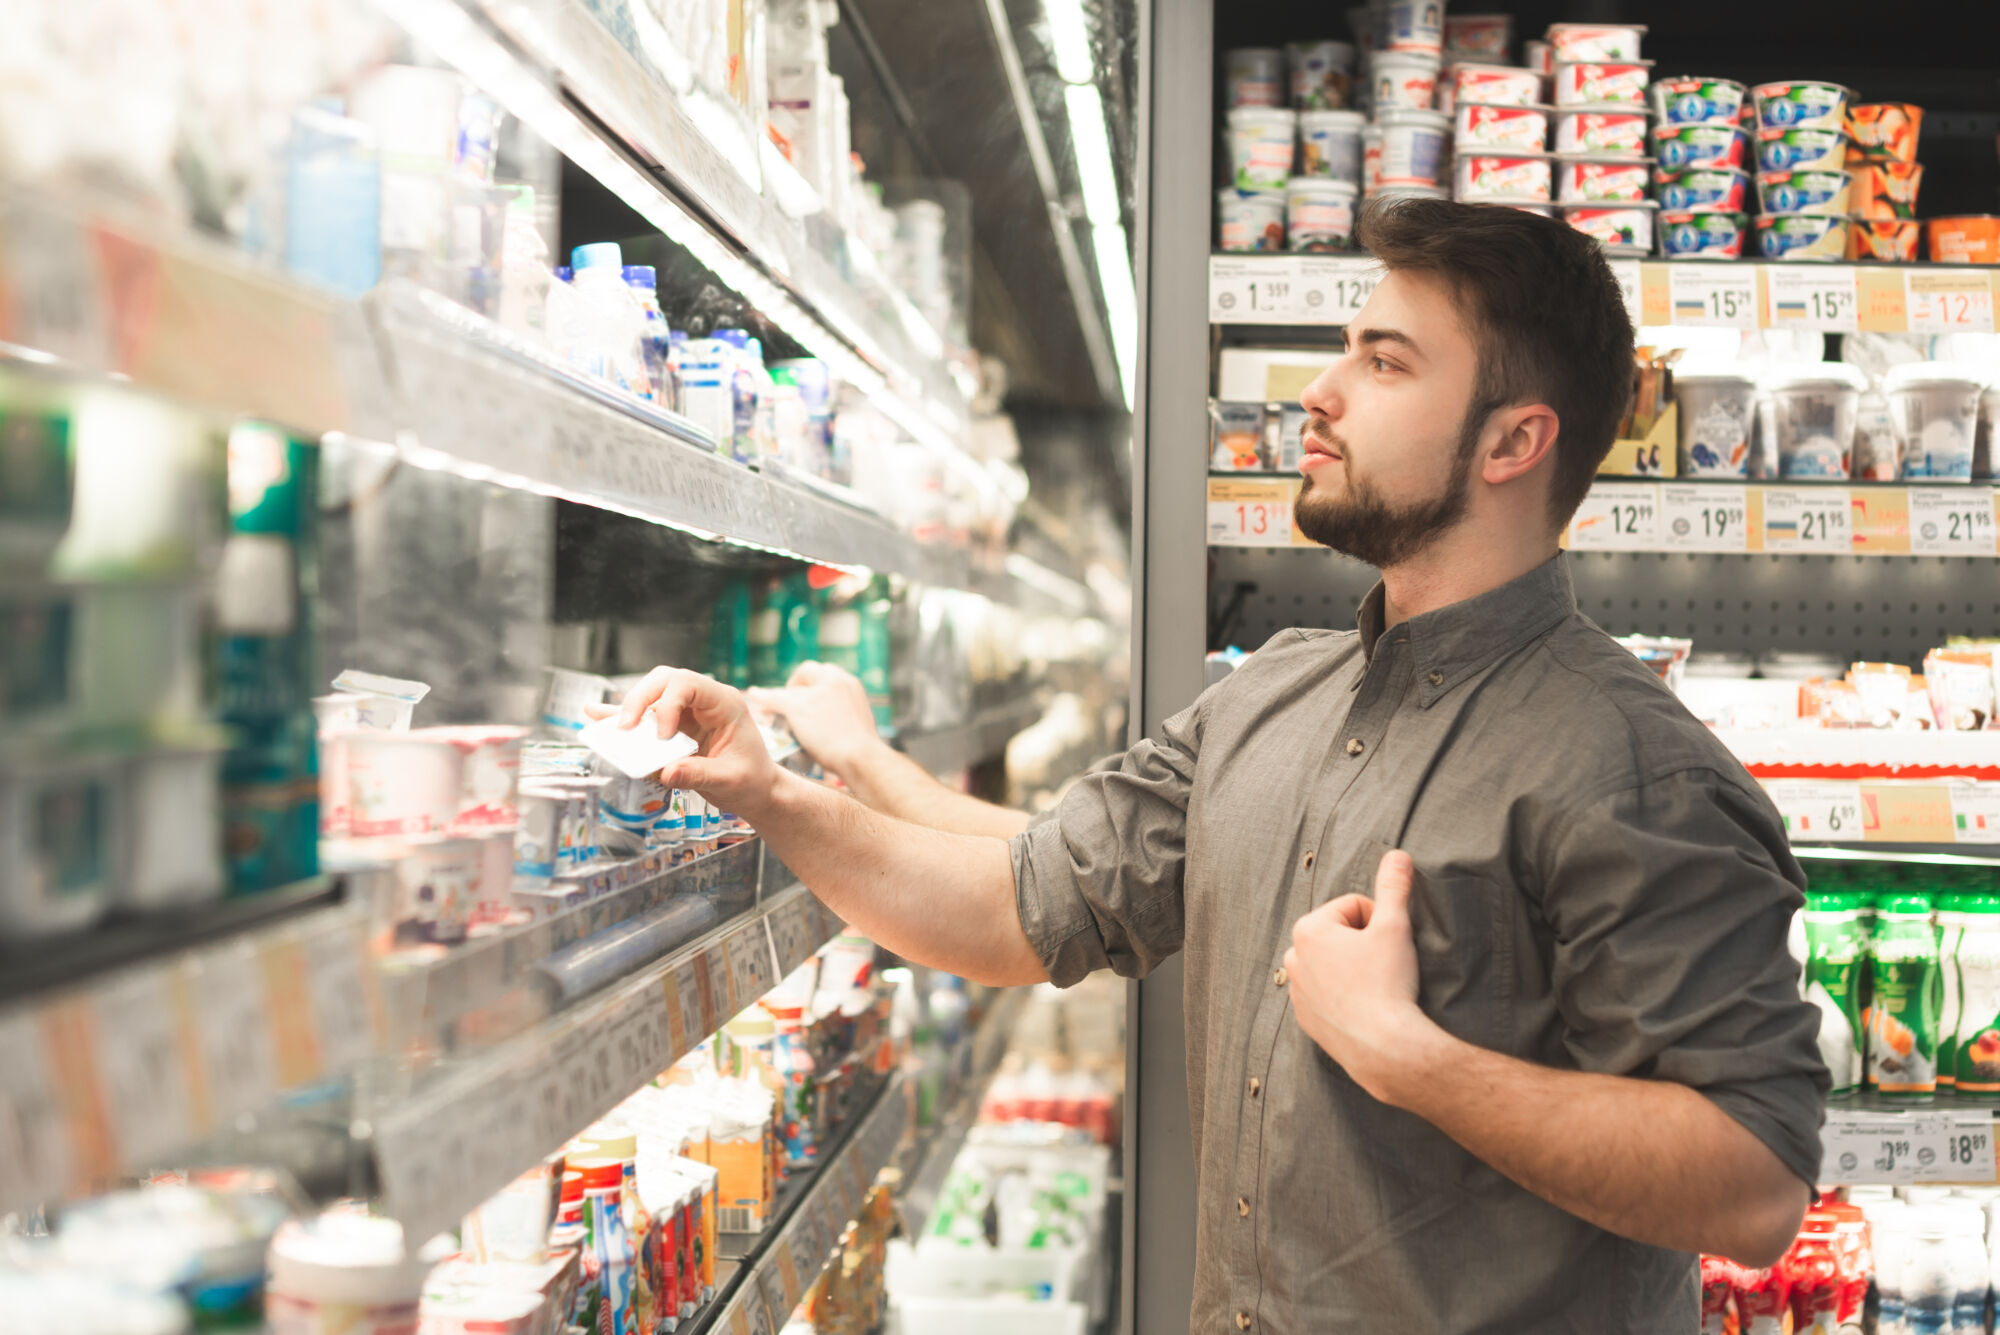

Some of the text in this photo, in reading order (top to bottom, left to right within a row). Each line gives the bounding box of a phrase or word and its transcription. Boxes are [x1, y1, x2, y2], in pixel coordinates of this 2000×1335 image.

[1711, 291, 1736, 318] 15
[1812, 292, 1838, 319] 15
[1939, 295, 1970, 323] 12
[1237, 505, 1267, 534] 13
[1611, 505, 1638, 534] 12
[1702, 508, 1727, 537] 19
[1801, 511, 1826, 540] 21
[1948, 512, 1972, 540] 21
[1829, 806, 1841, 831] 6
